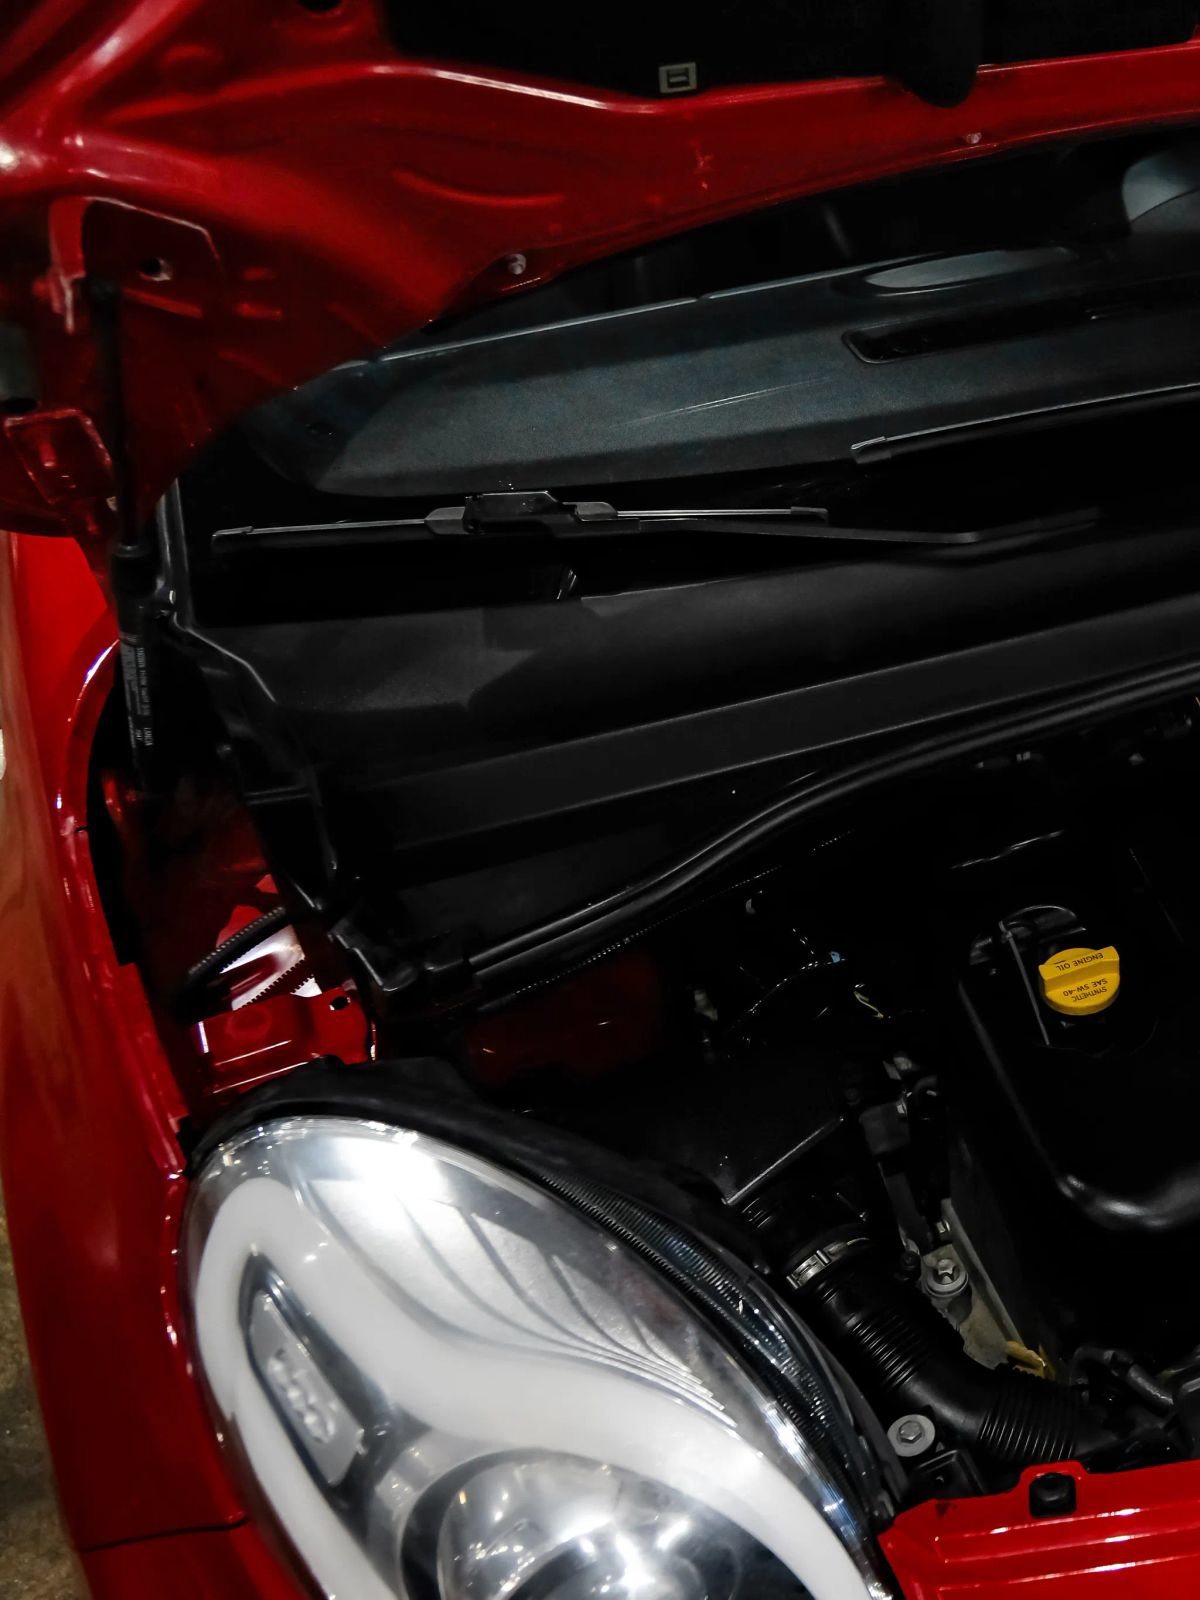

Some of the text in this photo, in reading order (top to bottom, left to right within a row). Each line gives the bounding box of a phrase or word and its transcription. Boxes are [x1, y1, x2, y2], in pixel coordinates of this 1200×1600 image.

[1056, 952, 1104, 972] ENGINE OIL
[1063, 978, 1108, 997] SAE 5W-40
[1072, 986, 1108, 1002] SYNTHETIC
